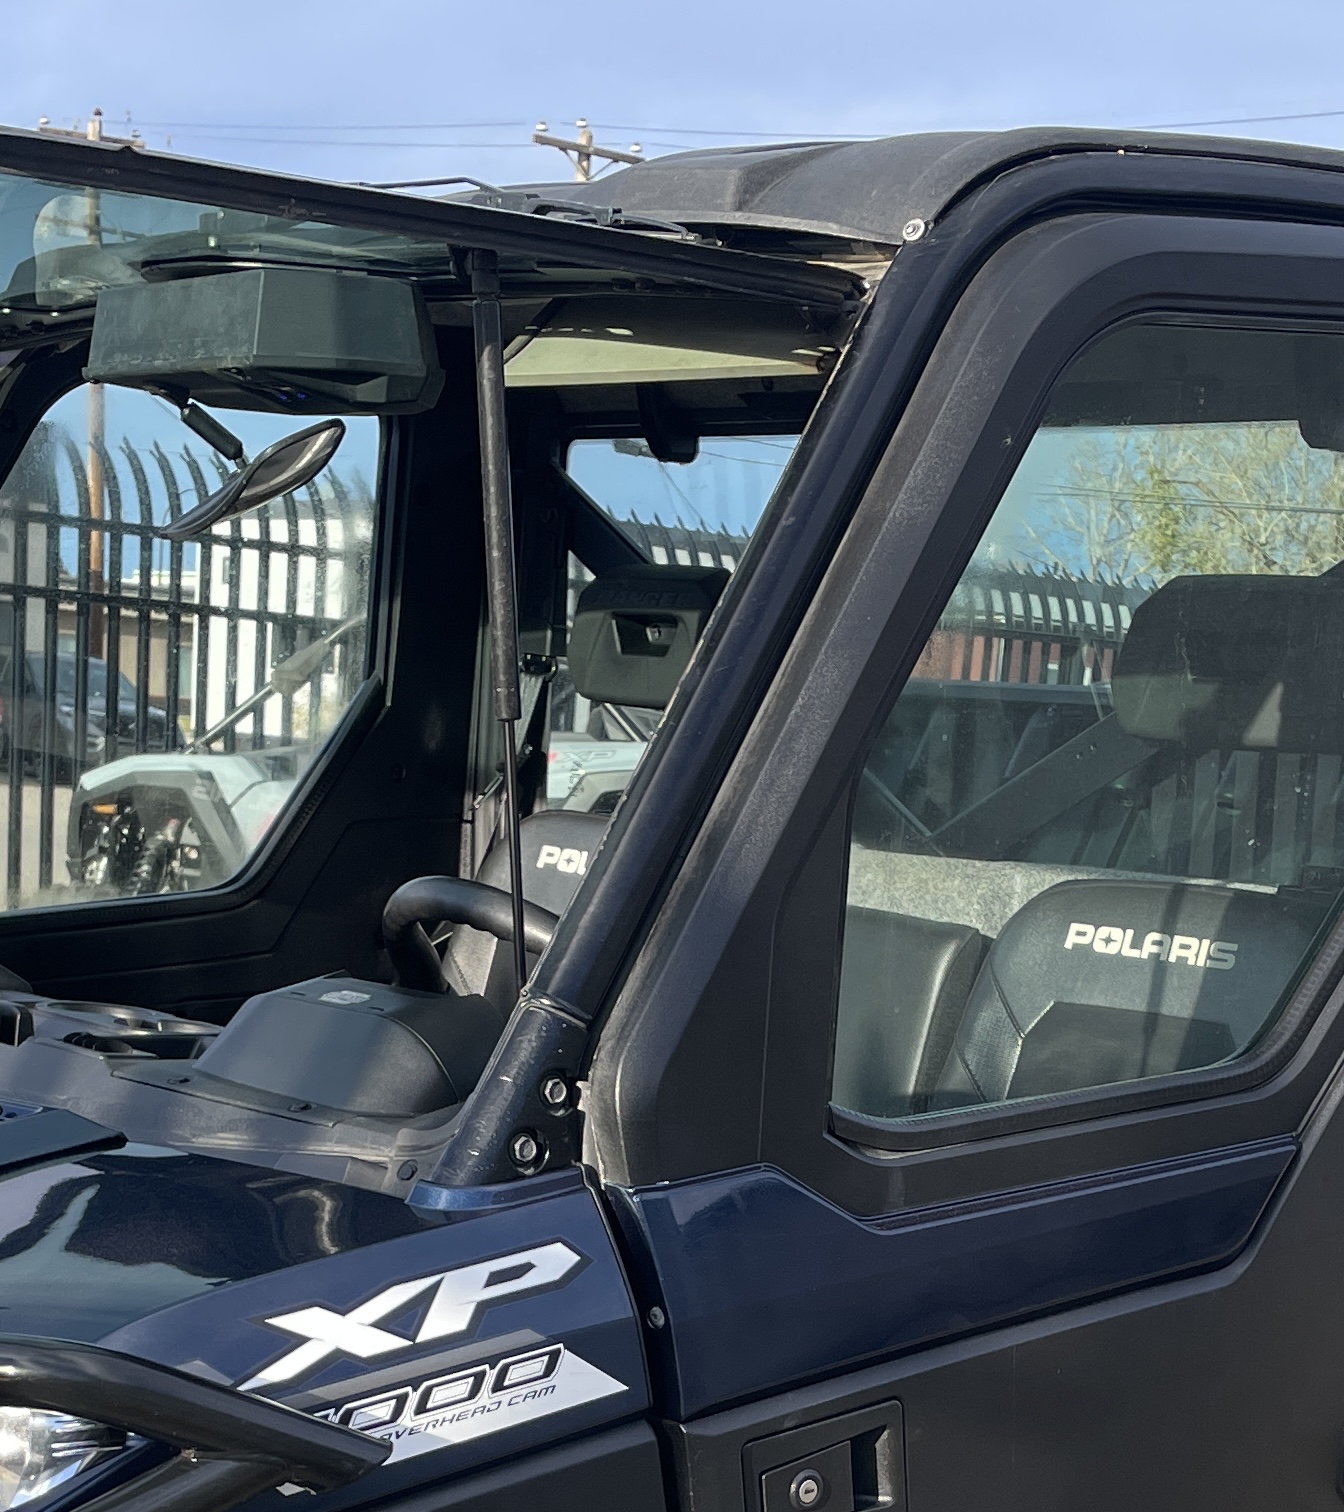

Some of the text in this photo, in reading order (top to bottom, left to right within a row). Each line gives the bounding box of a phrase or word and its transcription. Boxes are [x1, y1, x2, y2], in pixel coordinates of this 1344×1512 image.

[1064, 922, 1238, 970] POLARIS
[236, 1241, 584, 1392] XP
[507, 1384, 557, 1408] CAM
